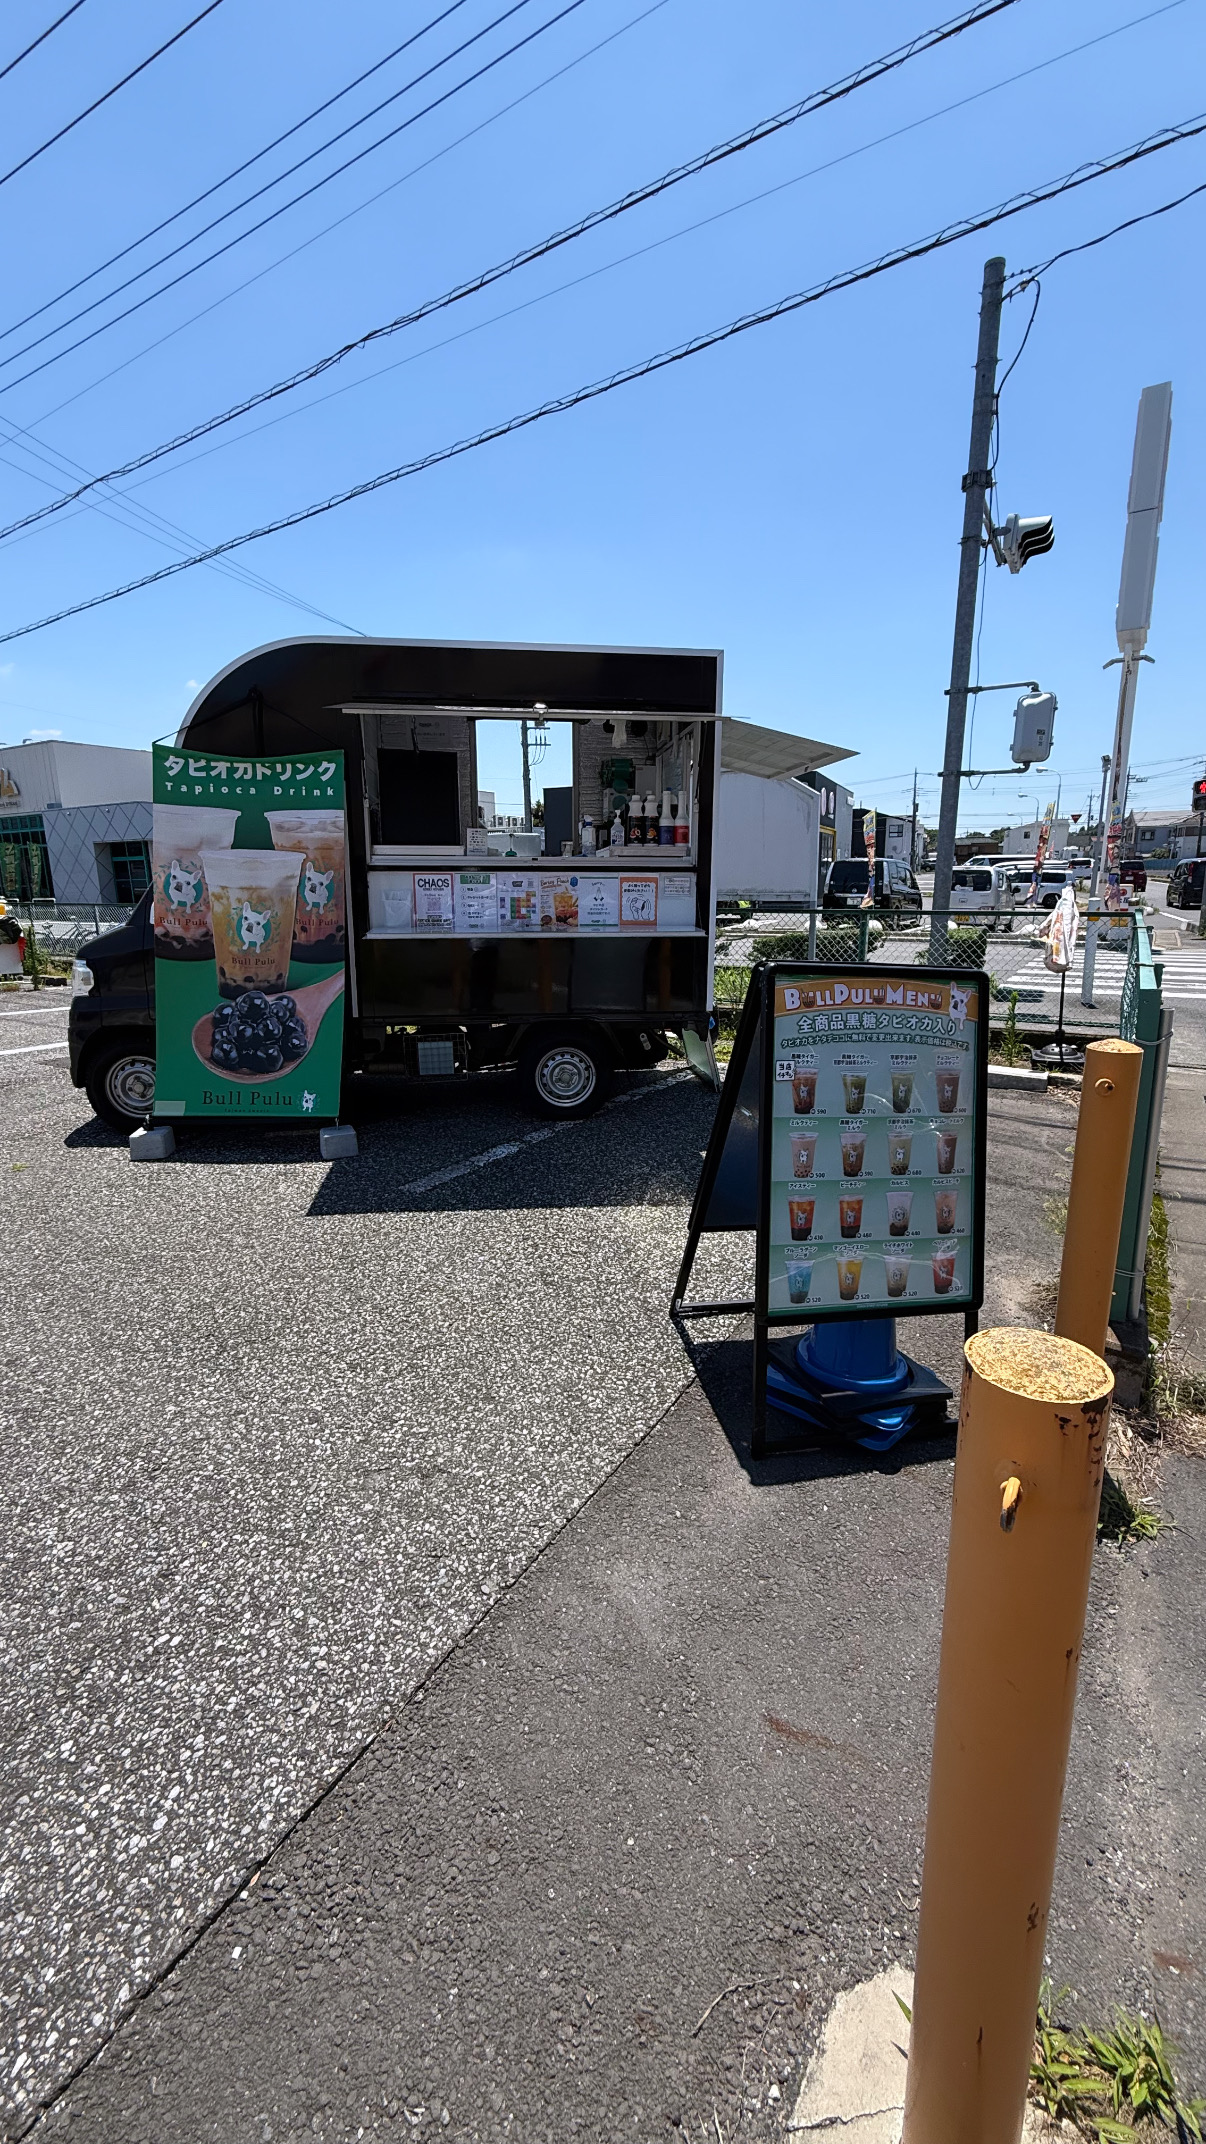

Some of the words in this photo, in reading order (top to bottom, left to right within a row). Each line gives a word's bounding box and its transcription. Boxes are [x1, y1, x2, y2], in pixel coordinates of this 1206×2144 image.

[165, 782, 256, 795] Tapioca
[273, 785, 334, 796] Drink
[417, 878, 450, 888] CHAOS
[159, 917, 181, 926] Bull
[184, 918, 208, 926] Pulu
[318, 918, 339, 926] Pulu
[231, 957, 251, 966] Bull
[254, 957, 276, 966] Pulu
[797, 1013, 957, 1036] 全商品黒糖タピオカ入り
[778, 1063, 792, 1071] 当店
[201, 1090, 242, 1105] Bull
[250, 1091, 293, 1106] Pulu
